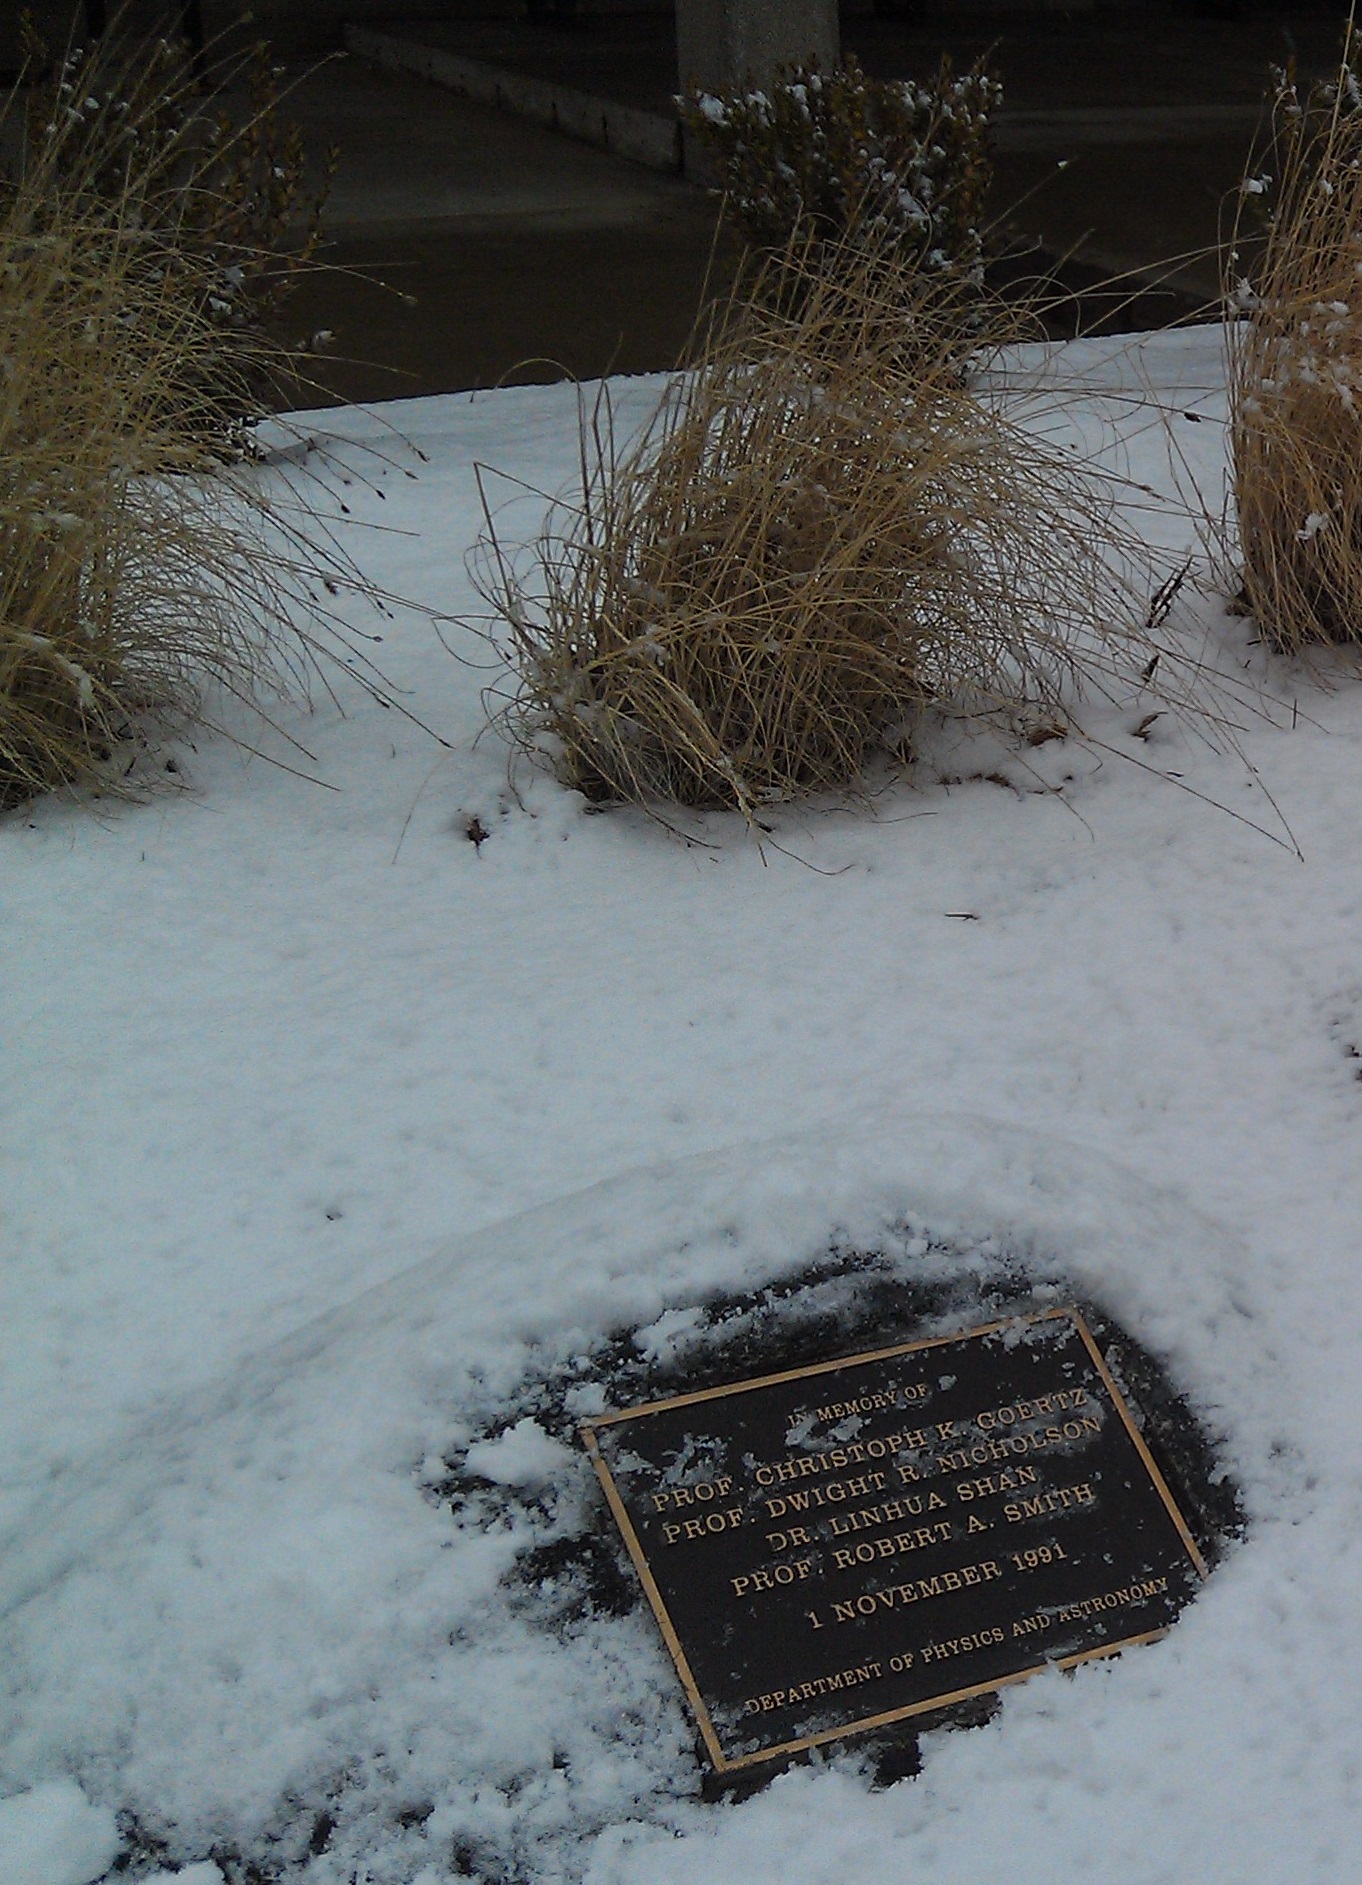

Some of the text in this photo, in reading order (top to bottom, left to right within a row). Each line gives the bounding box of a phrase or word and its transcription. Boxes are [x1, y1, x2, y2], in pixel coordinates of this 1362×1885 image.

[652, 1388, 1088, 1512] PROF. CHRISTOPH K. GOERTZ
[816, 1391, 897, 1422] MEMORY
[904, 1383, 927, 1400] OF
[663, 1417, 1102, 1544] PROF. DWIGHT R. NICHOLSON
[765, 1466, 1037, 1552] DR. LINHUA SHAN
[730, 1483, 1093, 1596] PROF. ROBERT A. SMITH
[807, 1543, 1068, 1629] 1 NOVEMBER 1991
[745, 1577, 1168, 1714] DEPARTMENT OF PHYSICS AND ASTRONOMY
